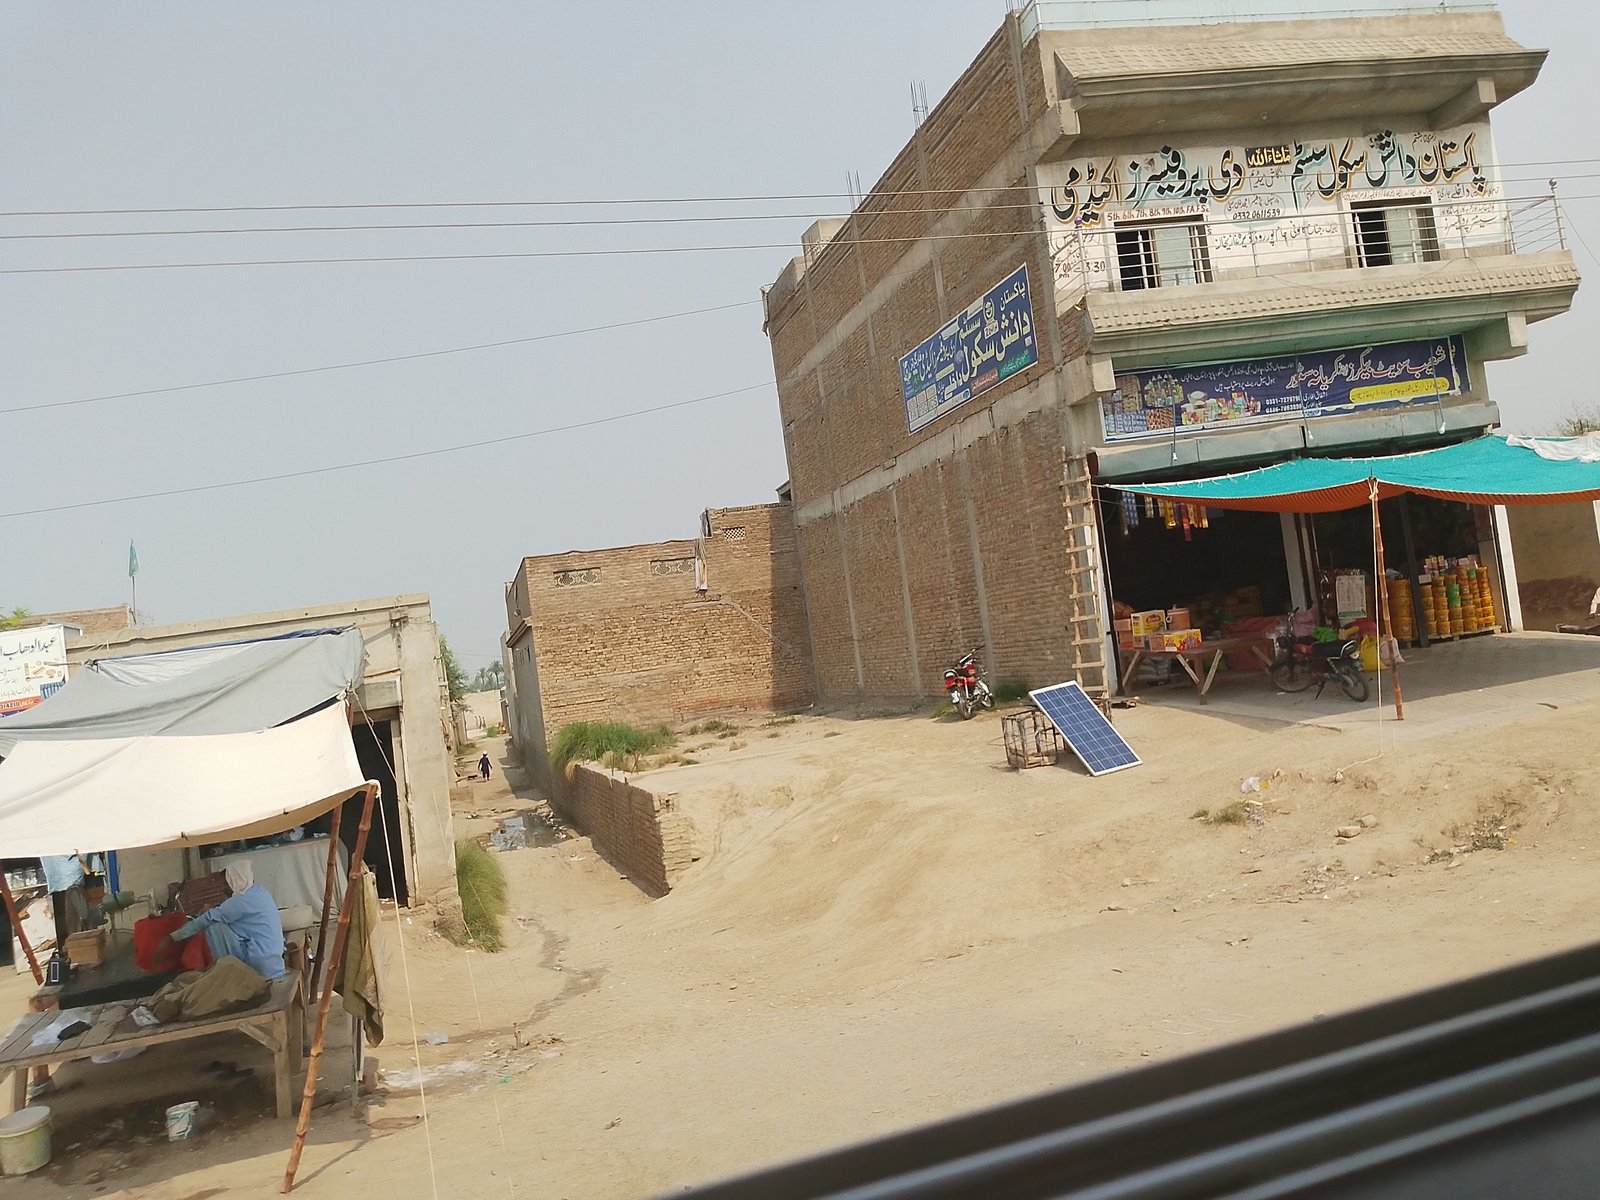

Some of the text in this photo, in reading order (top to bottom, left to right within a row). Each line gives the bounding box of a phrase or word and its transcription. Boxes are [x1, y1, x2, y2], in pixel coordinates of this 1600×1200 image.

[1125, 145, 1209, 208] پروفیسرز
[1208, 149, 1244, 201] دی
[1291, 138, 1328, 214] سسٹم
[1317, 137, 1368, 201] سکول
[1366, 129, 1416, 188] دانش
[1419, 131, 1486, 195] پاکستان
[1051, 157, 1124, 225] اکیڈمی
[1107, 212, 1120, 221] 5th
[1122, 211, 1135, 220] 6th
[1136, 209, 1148, 219] 7th
[1149, 208, 1161, 217] 8th
[1233, 207, 1281, 220] 0332 0611539
[999, 280, 1026, 311] پاکستان
[961, 331, 996, 382] سکول
[996, 308, 1031, 362] دانش
